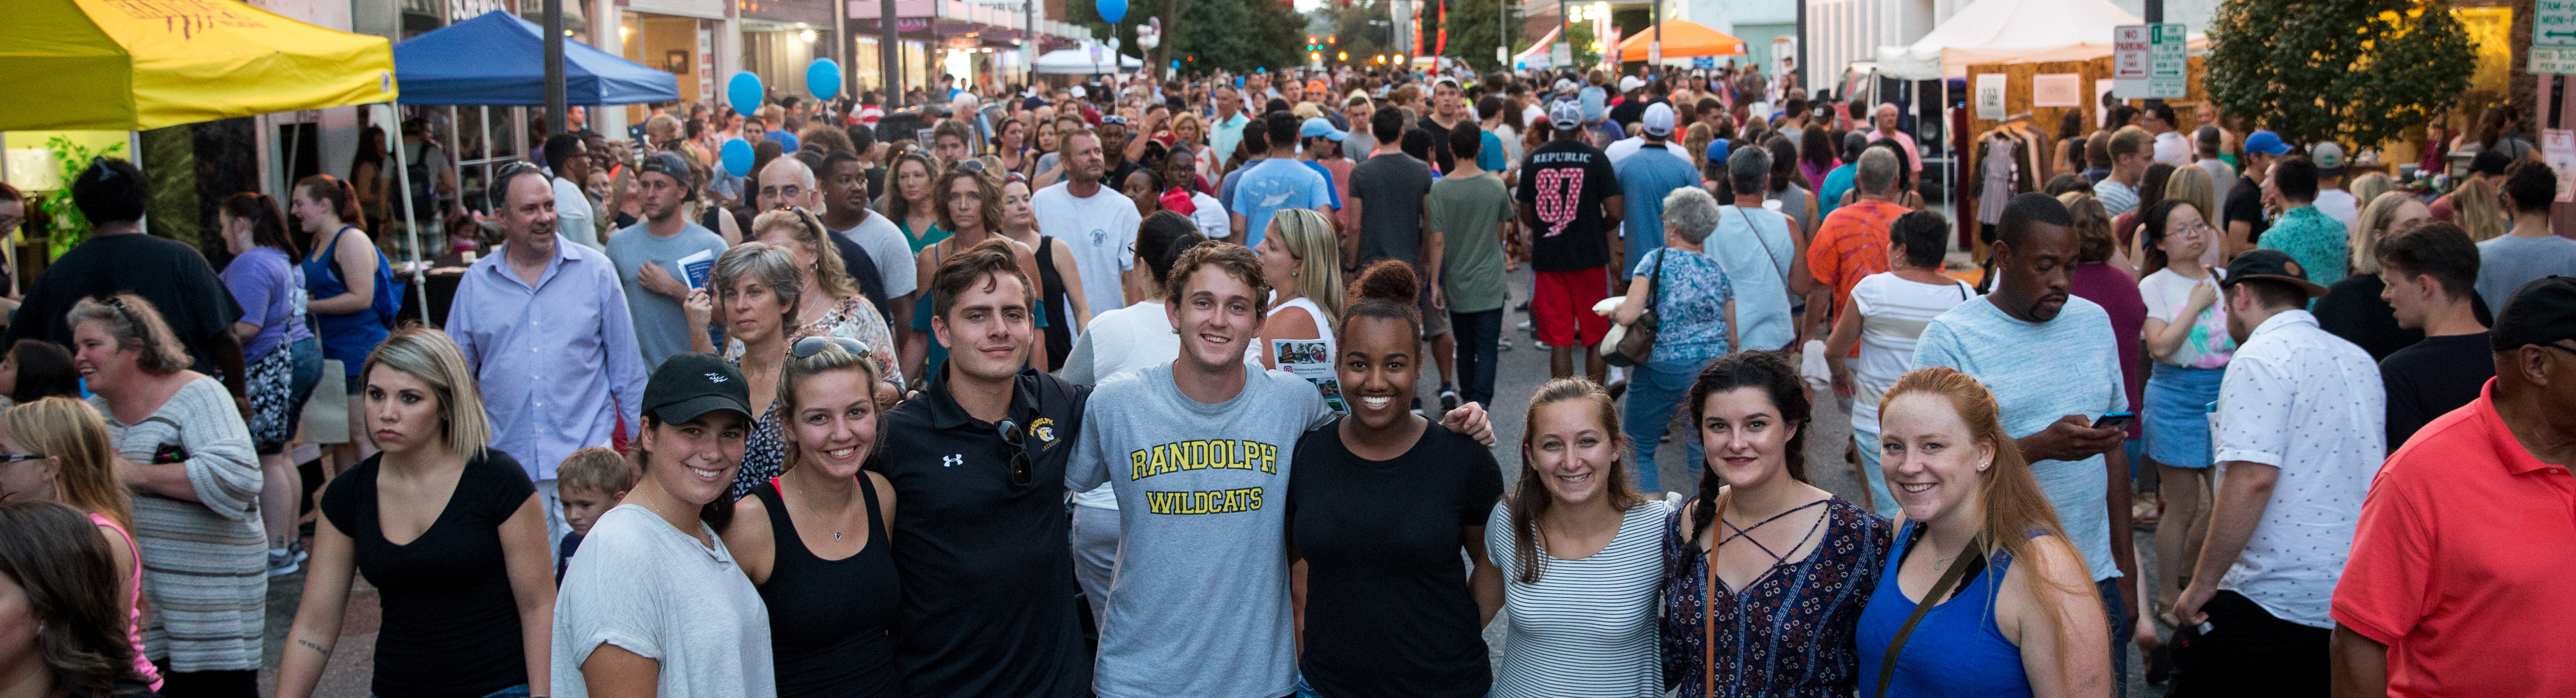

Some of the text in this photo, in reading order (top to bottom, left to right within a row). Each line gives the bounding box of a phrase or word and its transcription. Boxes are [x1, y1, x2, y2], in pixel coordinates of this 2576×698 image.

[2125, 30, 2137, 39] NO
[2116, 42, 2145, 51] PARKING
[1533, 152, 1592, 164] REPUBLIC
[1535, 167, 1584, 237] 87
[1030, 418, 1054, 437] RANDOLPH
[1042, 437, 1061, 451] LACROSSE
[1131, 439, 1278, 482] RANDOLPH
[1146, 487, 1264, 515] WILDCATS
